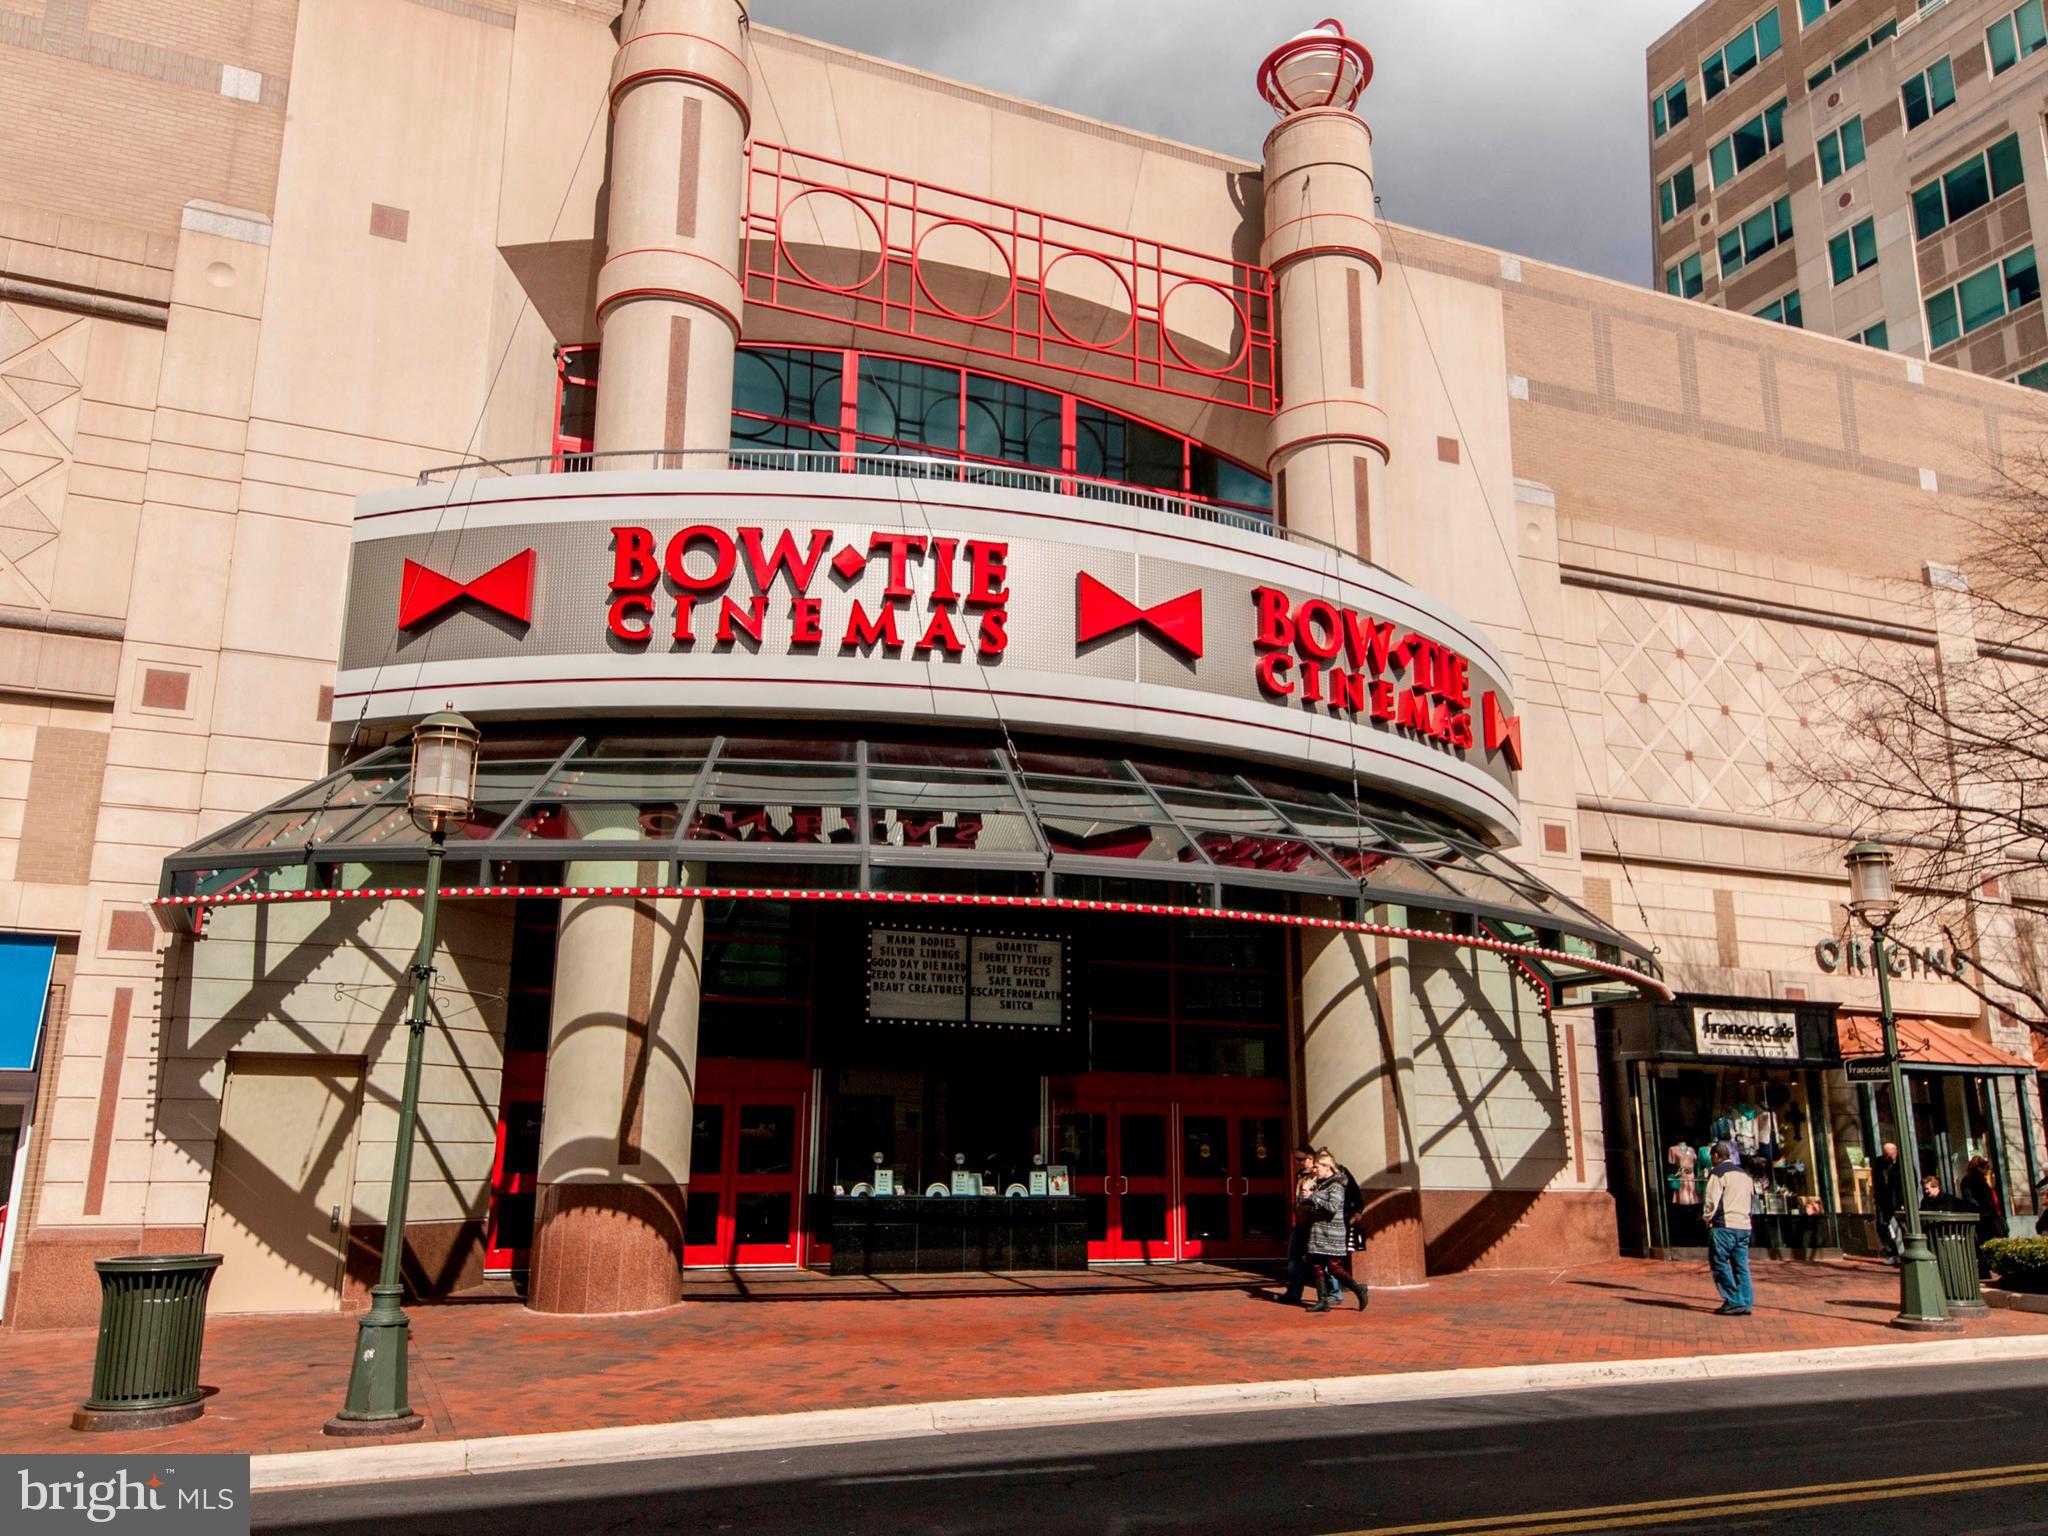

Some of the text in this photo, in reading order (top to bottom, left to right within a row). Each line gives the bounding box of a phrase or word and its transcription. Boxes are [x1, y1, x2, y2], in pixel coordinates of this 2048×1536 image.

[608, 525, 1009, 605] BOW TIE
[608, 594, 1009, 656] CINEMAS
[1251, 585, 1472, 709] BOW TIE
[1255, 652, 1473, 749] CINEMAS
[887, 935, 956, 948] WARM BODIES
[996, 941, 1038, 953] QUARTET
[880, 946, 960, 960] SILVER LININGS
[979, 952, 1053, 965] IDENTITY THIEF
[1815, 937, 1967, 979] ORGINS
[871, 957, 897, 968] GOOD
[900, 959, 919, 969] DAY
[871, 969, 967, 984] ZERO DARK THIRTY
[986, 964, 1050, 977] SIDE EFFECTS
[873, 981, 964, 995] BEAUT CREATURES
[989, 976, 1046, 988] SAFE HAVEN
[1000, 1000, 1033, 1012] SNITCH
[1848, 1062, 1889, 1075] francesca
